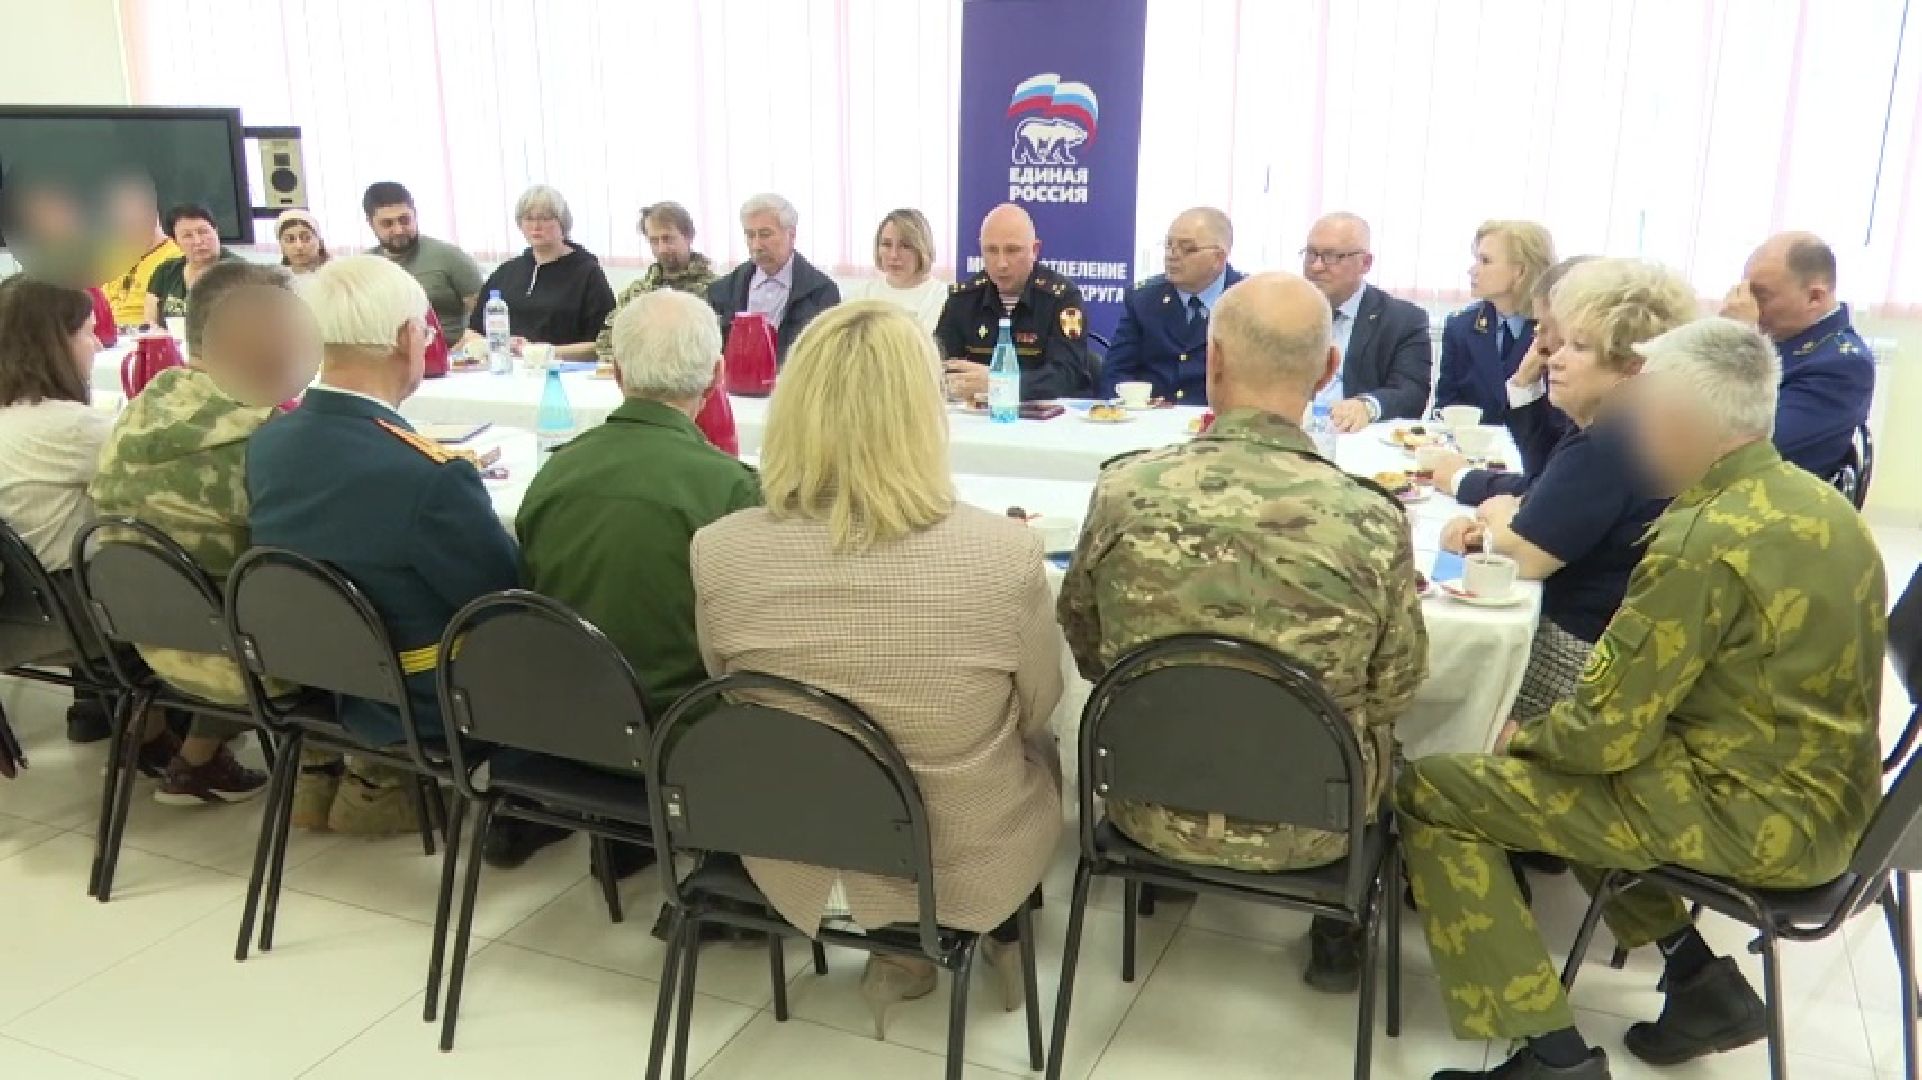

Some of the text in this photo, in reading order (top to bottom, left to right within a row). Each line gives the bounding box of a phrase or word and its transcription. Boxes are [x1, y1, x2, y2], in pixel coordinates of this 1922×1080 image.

[1009, 167, 1088, 185] ЕДИНАЯ
[1009, 185, 1088, 203] РОССИЯ
[1078, 284, 1124, 303] КРУГА
